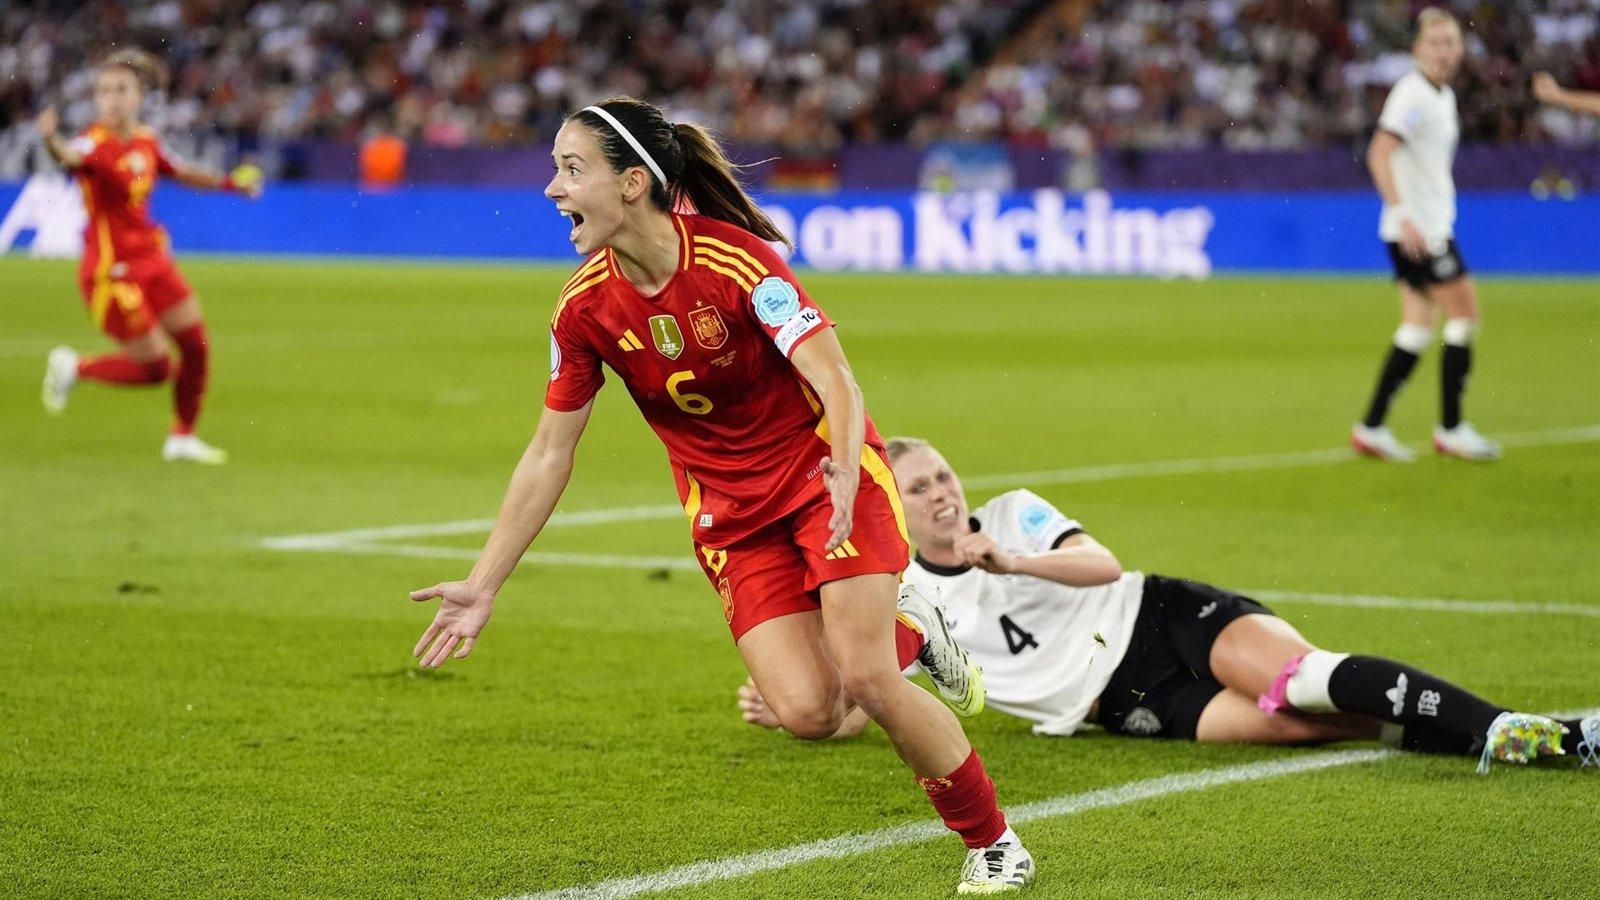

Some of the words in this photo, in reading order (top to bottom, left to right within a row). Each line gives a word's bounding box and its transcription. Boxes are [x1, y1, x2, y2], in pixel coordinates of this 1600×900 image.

[801, 205, 902, 270] on
[914, 189, 1214, 279] Kicking
[666, 370, 713, 415] 6
[1000, 614, 1039, 655] 4
